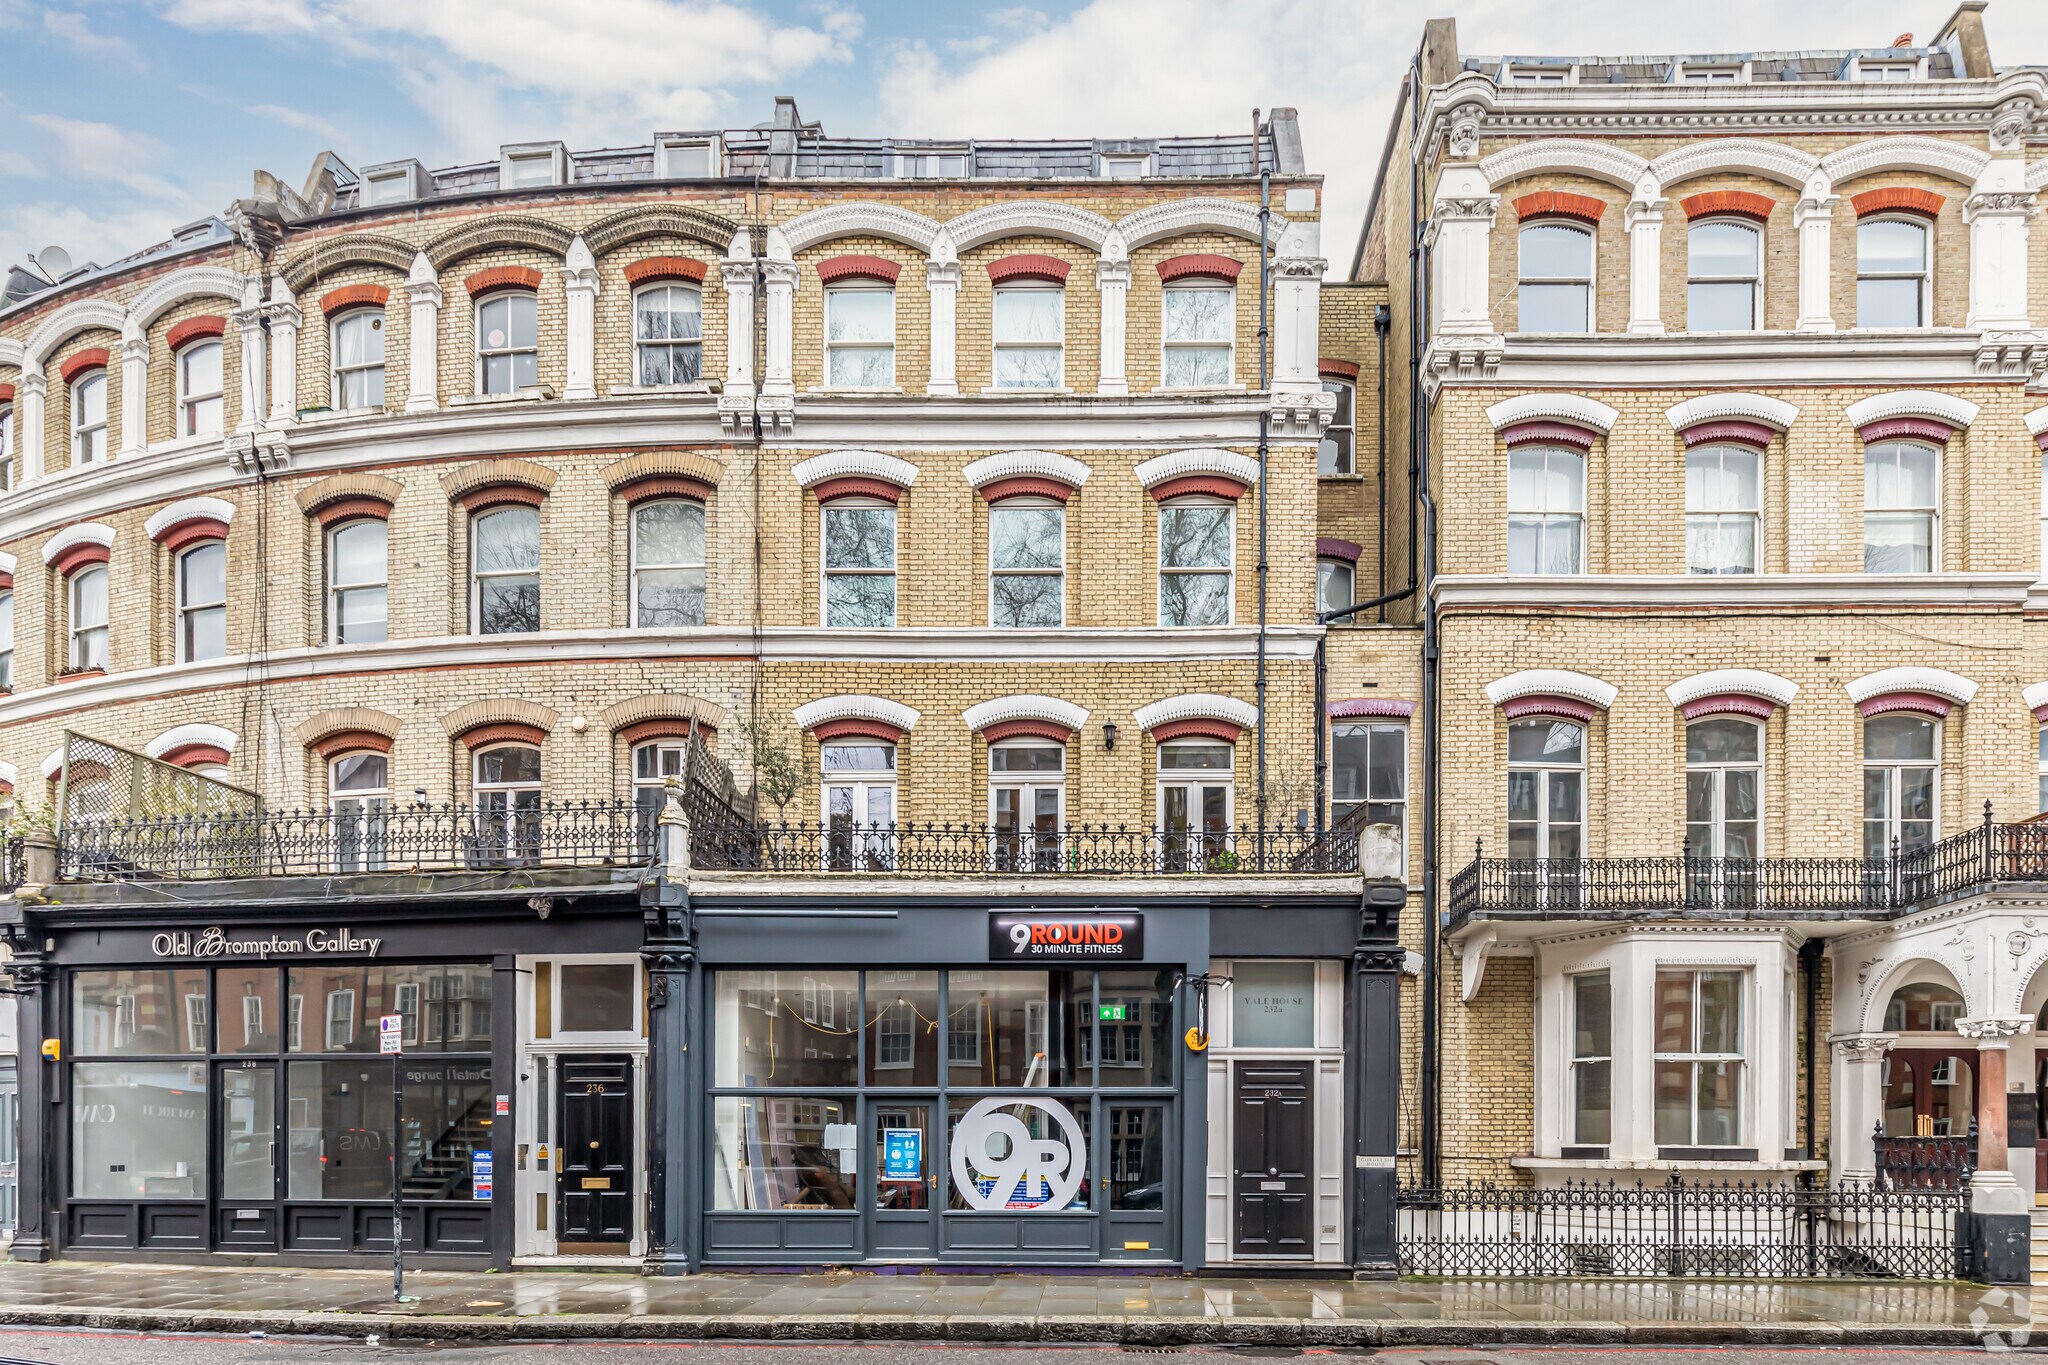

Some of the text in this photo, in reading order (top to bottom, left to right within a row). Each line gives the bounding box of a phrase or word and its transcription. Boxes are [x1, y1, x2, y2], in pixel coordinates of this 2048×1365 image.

[152, 925, 382, 960] Old Brompton Gallery
[1009, 923, 1124, 954] 9ROUND
[1031, 944, 1123, 954] 30 MINUTE FITNESS
[1272, 997, 1304, 1005] HOUSE
[1264, 1005, 1283, 1013] 232a
[586, 1084, 605, 1093] 236
